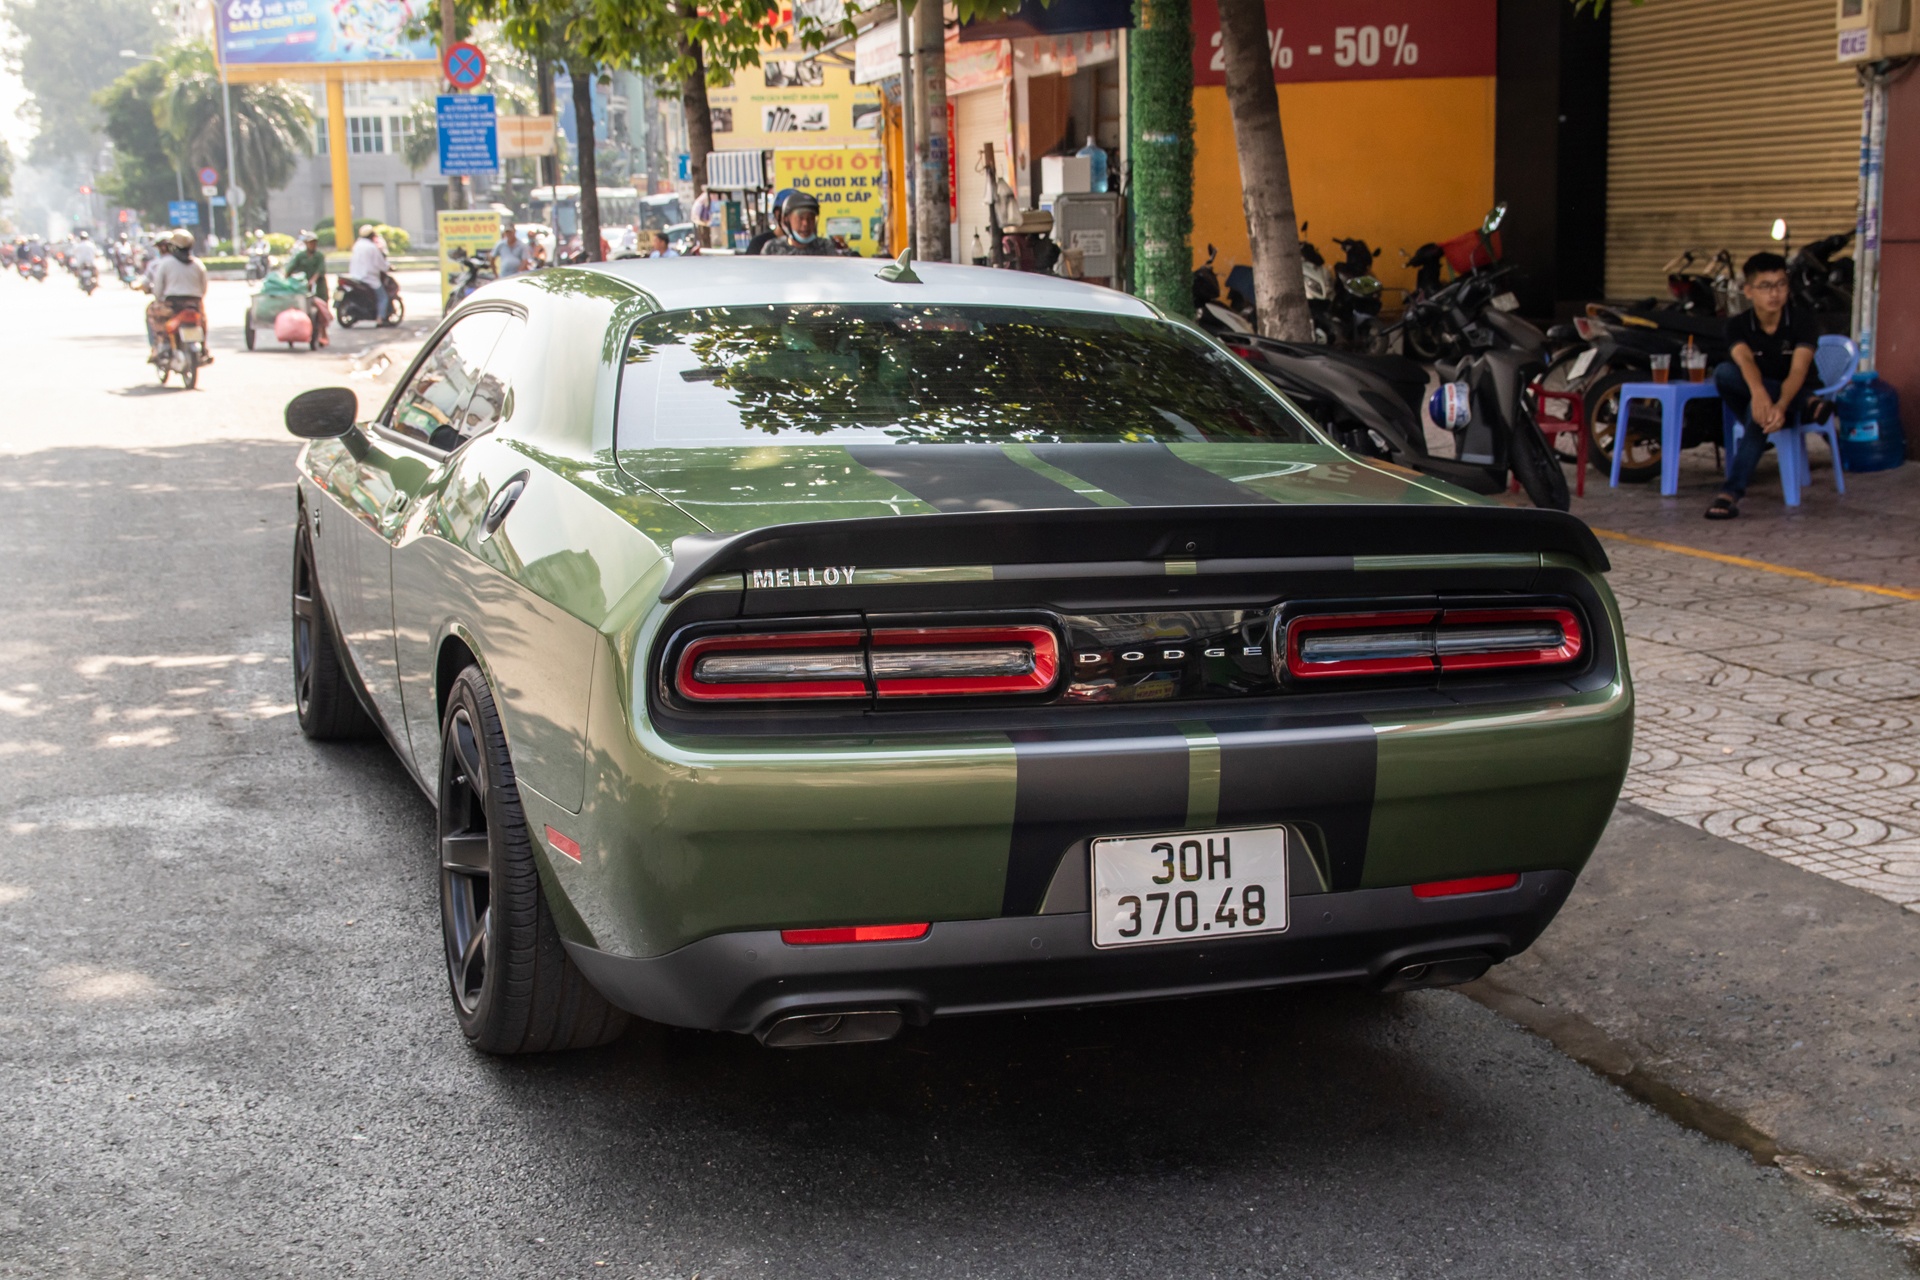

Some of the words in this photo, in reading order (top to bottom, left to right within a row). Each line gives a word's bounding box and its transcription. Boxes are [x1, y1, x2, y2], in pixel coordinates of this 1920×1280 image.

[1210, 28, 1293, 71] 2%
[1334, 24, 1418, 67] 50%
[781, 153, 843, 171] TƯƠI
[850, 176, 869, 187] XE
[816, 192, 841, 203] CAO
[752, 565, 856, 589] MELLOY
[1079, 646, 1262, 663] DODGE
[1150, 837, 1231, 885] 30H
[1117, 884, 1266, 937] 370.48
